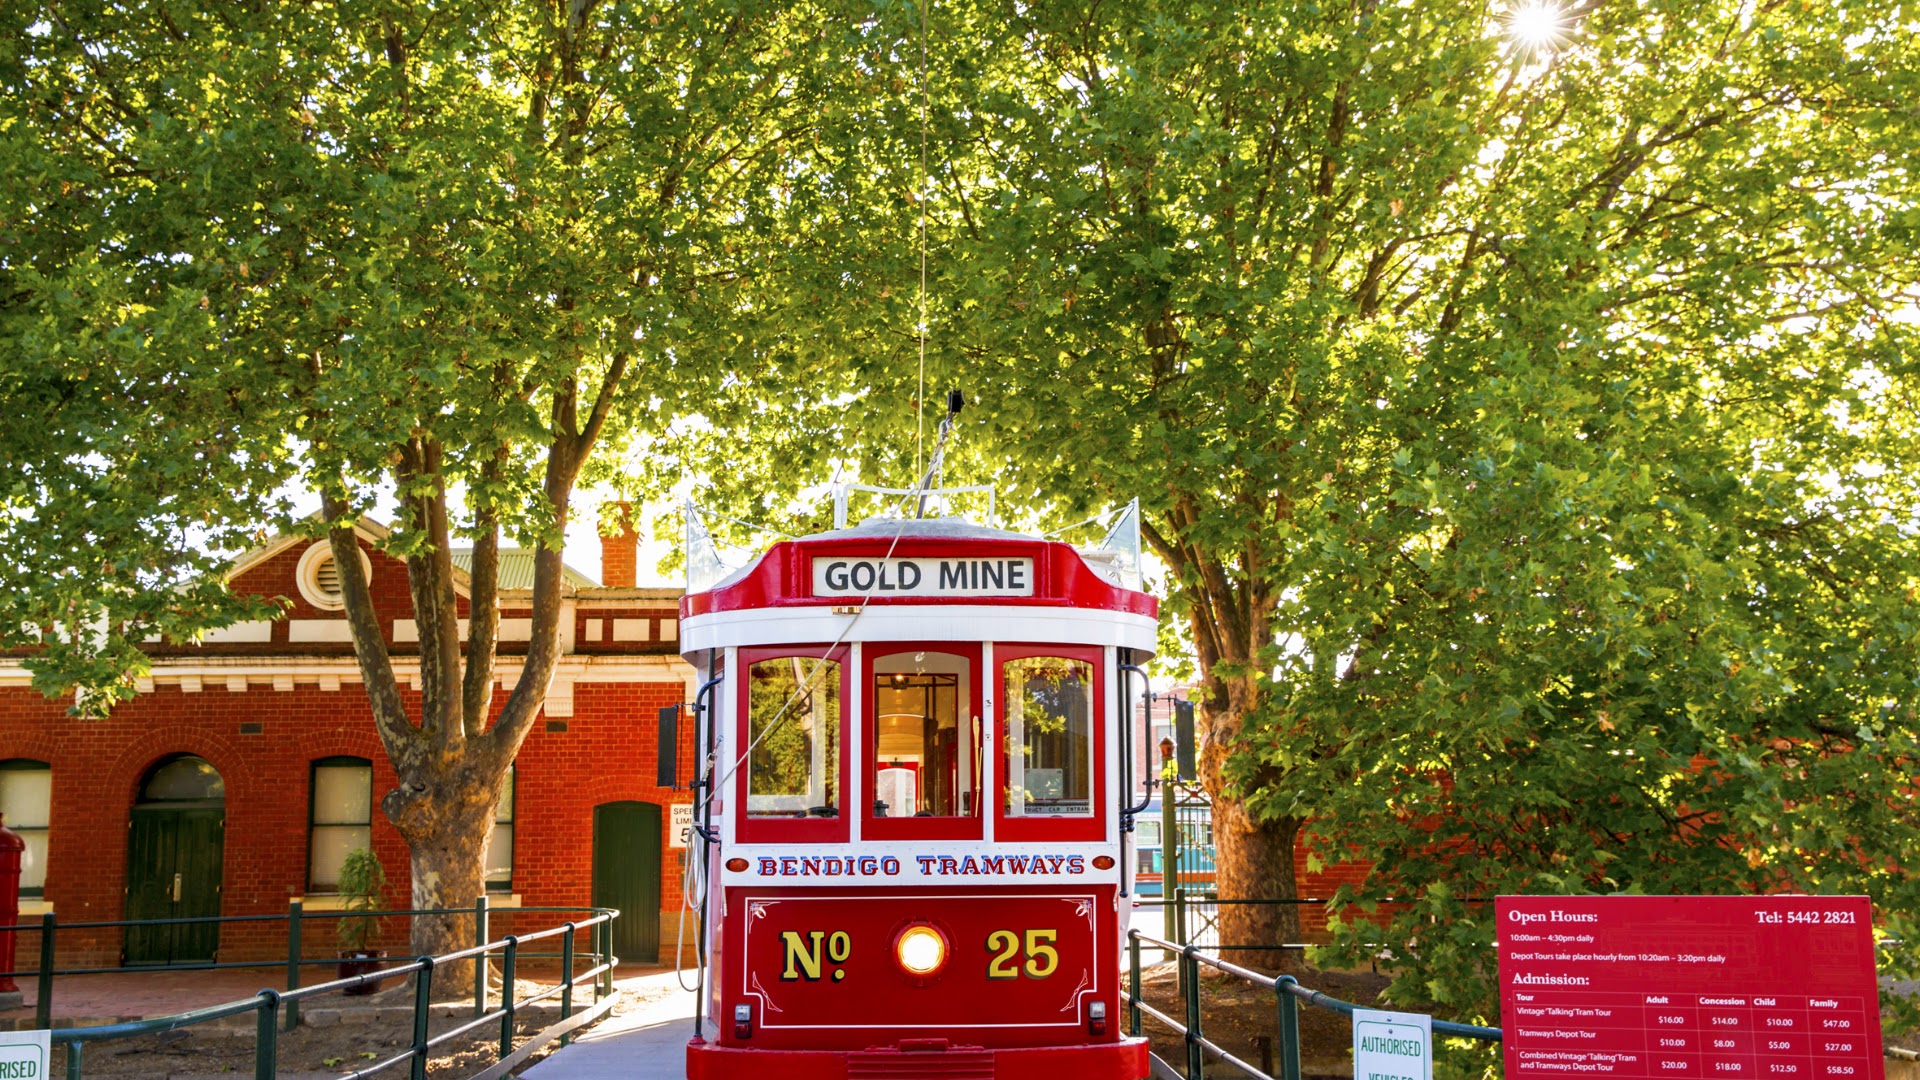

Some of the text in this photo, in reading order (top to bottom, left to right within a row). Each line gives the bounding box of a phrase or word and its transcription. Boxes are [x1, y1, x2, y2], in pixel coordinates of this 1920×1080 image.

[825, 560, 1025, 591] GOLD MINE
[757, 854, 1085, 876] BENDIGO TRAMWAYS
[1508, 910, 1598, 925] Open Hours:
[1755, 911, 1856, 923] Tel: 5442 2821
[1510, 934, 1540, 942] 10:00am
[1547, 935, 1575, 943] 4:30pm
[1576, 934, 1594, 943] daily
[985, 929, 1059, 980] 25
[1511, 952, 1533, 961] Depot
[1534, 952, 1554, 960] Tours
[1555, 953, 1571, 961] take
[1572, 953, 1592, 962] place
[1593, 953, 1617, 963] hourly
[1618, 953, 1636, 962] from
[1638, 954, 1670, 962] 10:20am
[1677, 954, 1706, 963] 3:20pm
[1707, 954, 1726, 964] daily
[1512, 973, 1590, 985] Admission:
[1516, 993, 1838, 1009] Tour Adult Concession Child Family
[1517, 1007, 1545, 1016] Vintage
[1575, 1008, 1594, 1016] Tram
[1594, 1009, 1611, 1017] Tour
[1658, 1016, 1850, 1028] $16.00 $14.00 $10.00 $47.00
[1518, 1029, 1554, 1038] Tramways
[1555, 1030, 1578, 1039] Depot
[1361, 1036, 1420, 1057] AUTHORISED
[1660, 1038, 1852, 1051] $10.00 $8.00 $5.00 $27.00
[1519, 1051, 1557, 1060] Combined
[1558, 1052, 1586, 1061] Vintage
[1617, 1054, 1636, 1062] Tram
[1535, 1062, 1572, 1071] Tramways
[1573, 1063, 1595, 1072] Depot
[1661, 1061, 1854, 1074] $20.00 $18.00 $12.50 $58.50
